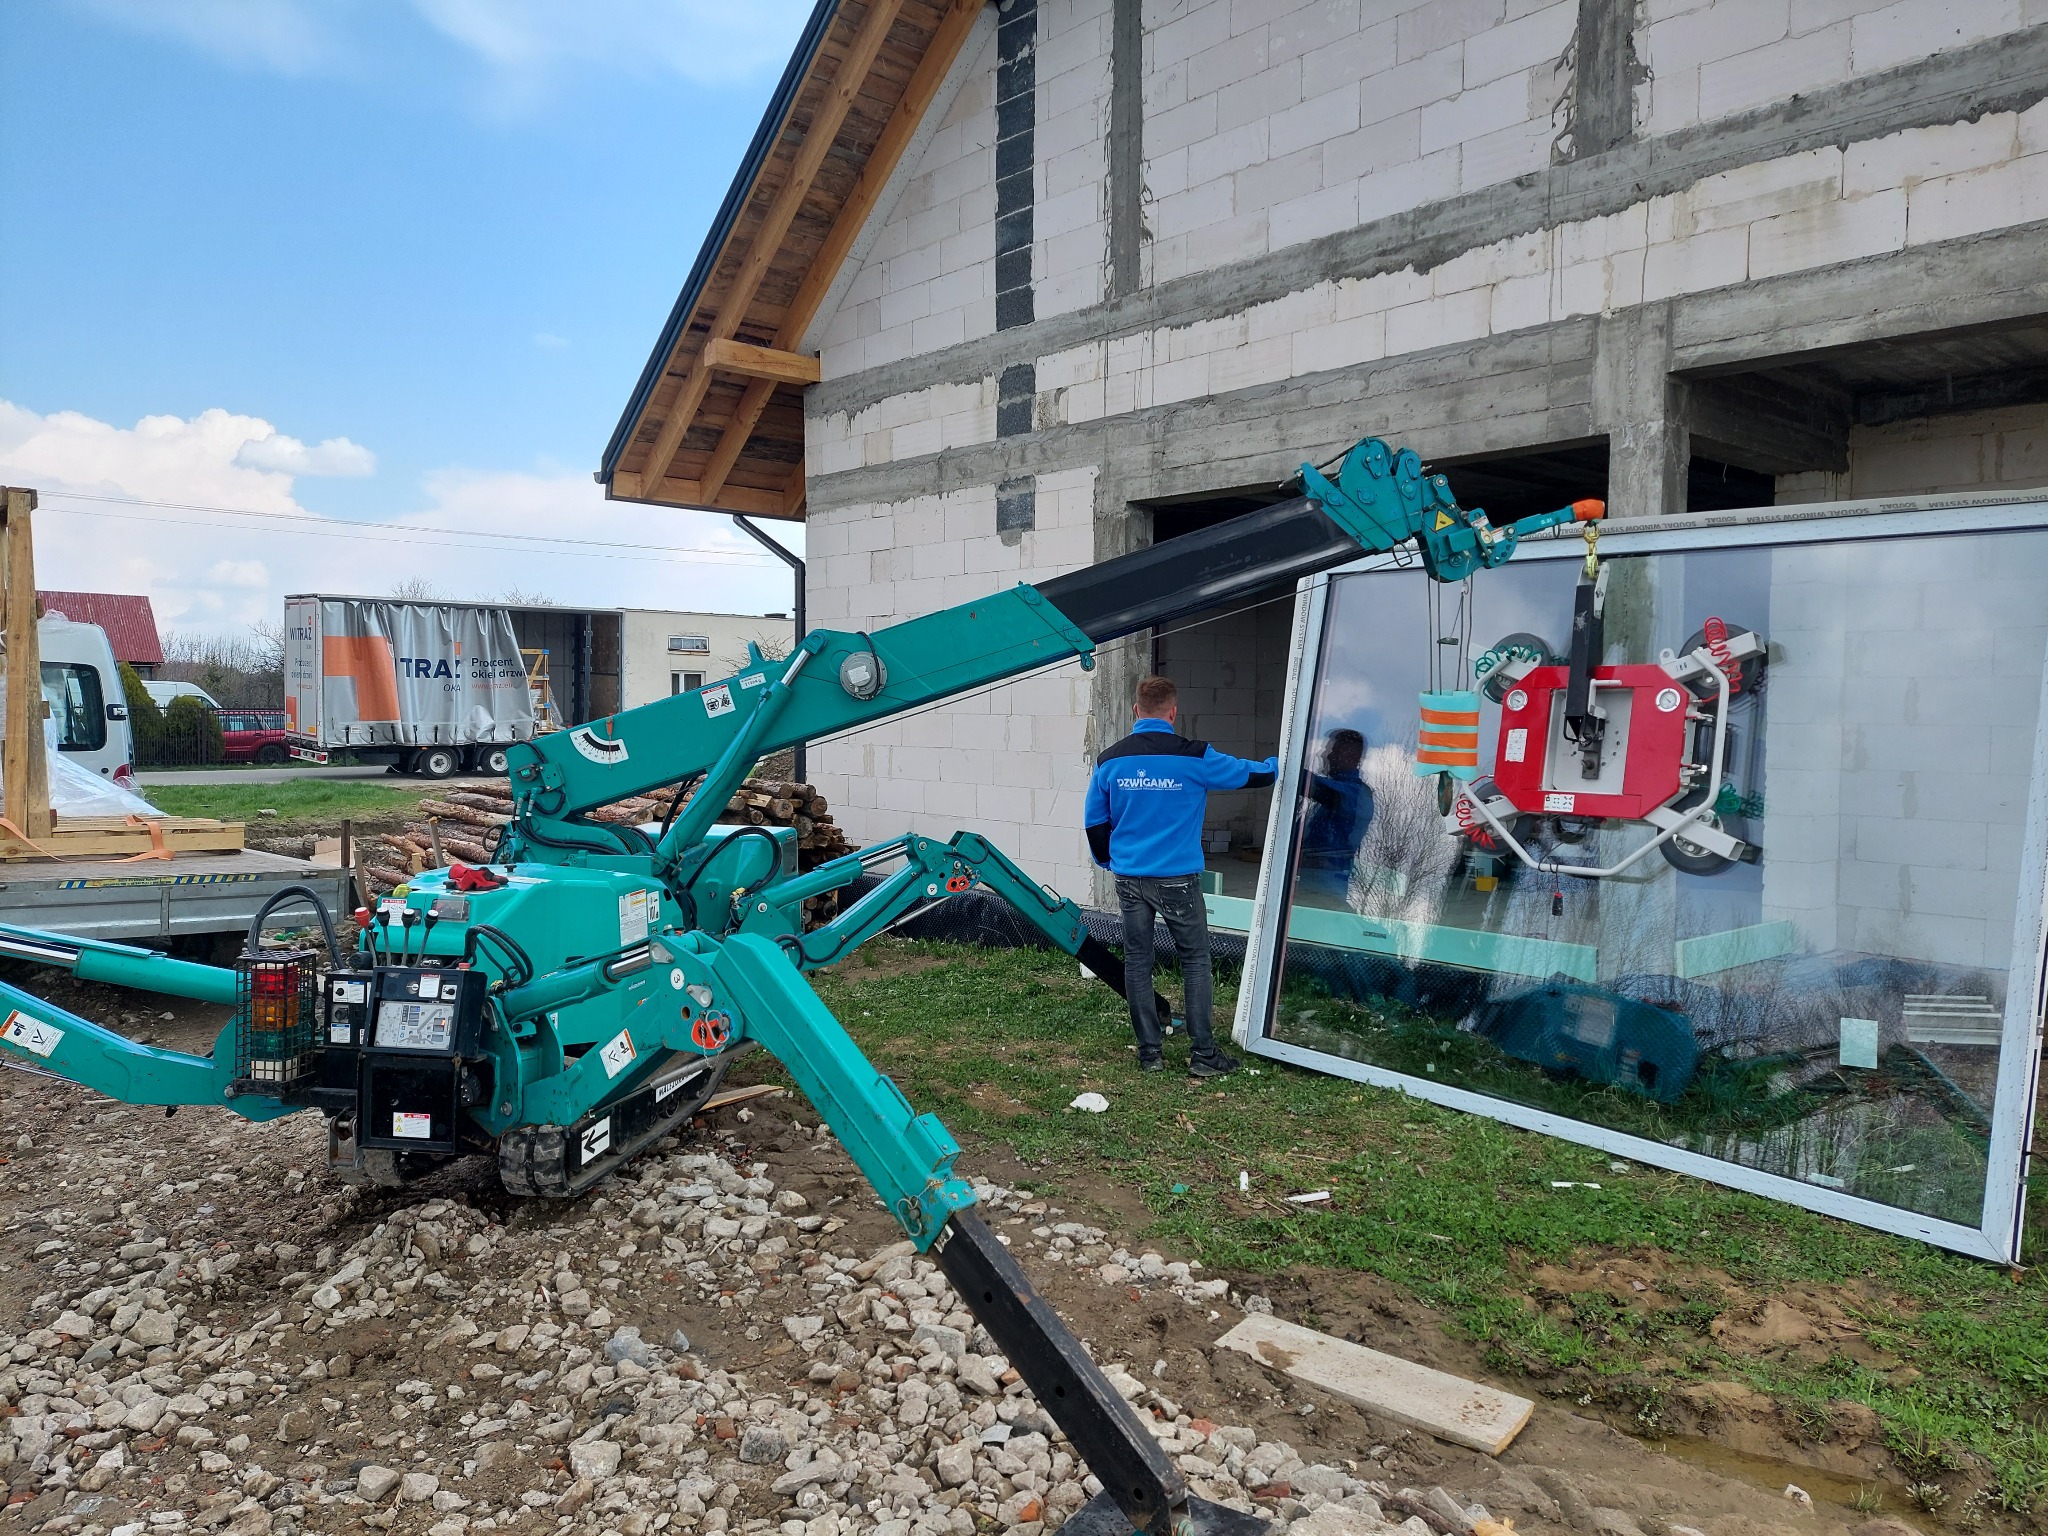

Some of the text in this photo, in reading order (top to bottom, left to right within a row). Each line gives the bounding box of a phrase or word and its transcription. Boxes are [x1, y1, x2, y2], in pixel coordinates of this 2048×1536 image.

[1929, 499, 1969, 508] SYSTEM
[1972, 496, 2022, 505] WINDOW
[1747, 507, 1870, 523] SOUDAL WINDOW SYSTEM
[1625, 523, 1661, 533] WINDOW
[1662, 520, 1697, 529] SOUDAL
[1297, 624, 1305, 650] SYSTEM
[1242, 935, 1259, 1022] SOUDAL WINDOW SYSTEM
